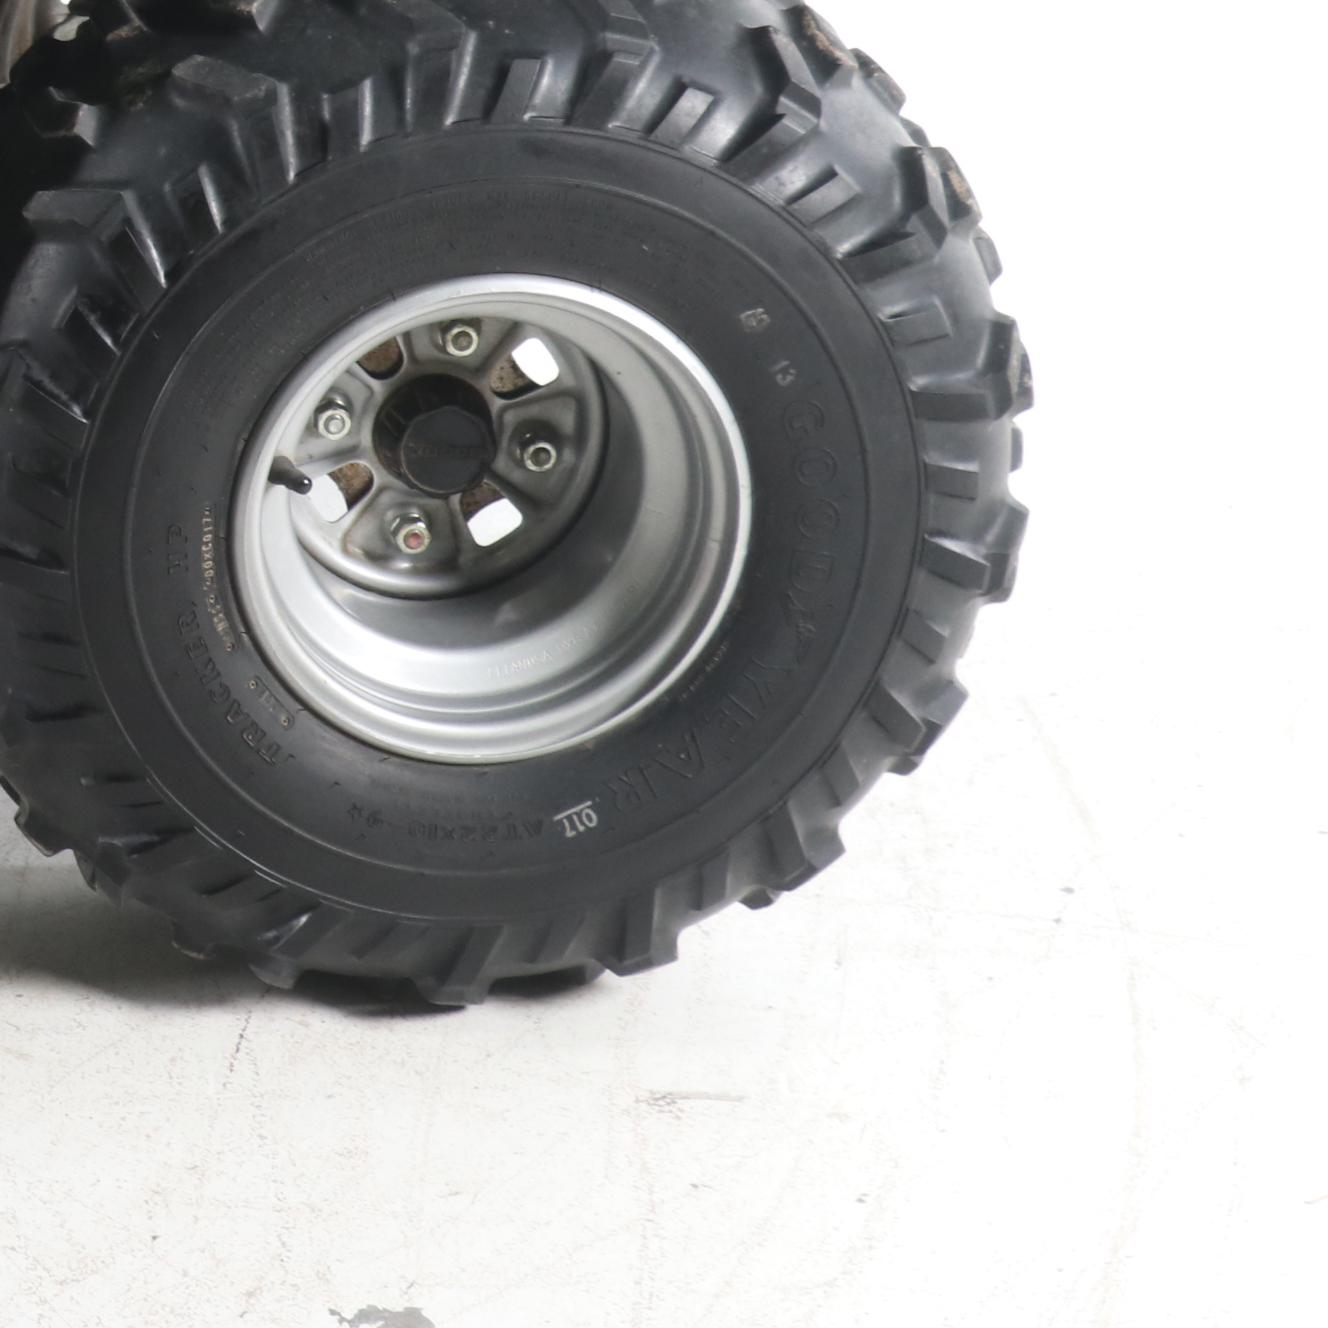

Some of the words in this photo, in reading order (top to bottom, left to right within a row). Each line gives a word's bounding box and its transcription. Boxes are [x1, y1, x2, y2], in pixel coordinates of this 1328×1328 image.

[606, 399, 842, 810] GOODYEAR
[178, 605, 284, 766] TRACKER
[560, 806, 599, 838] 017
